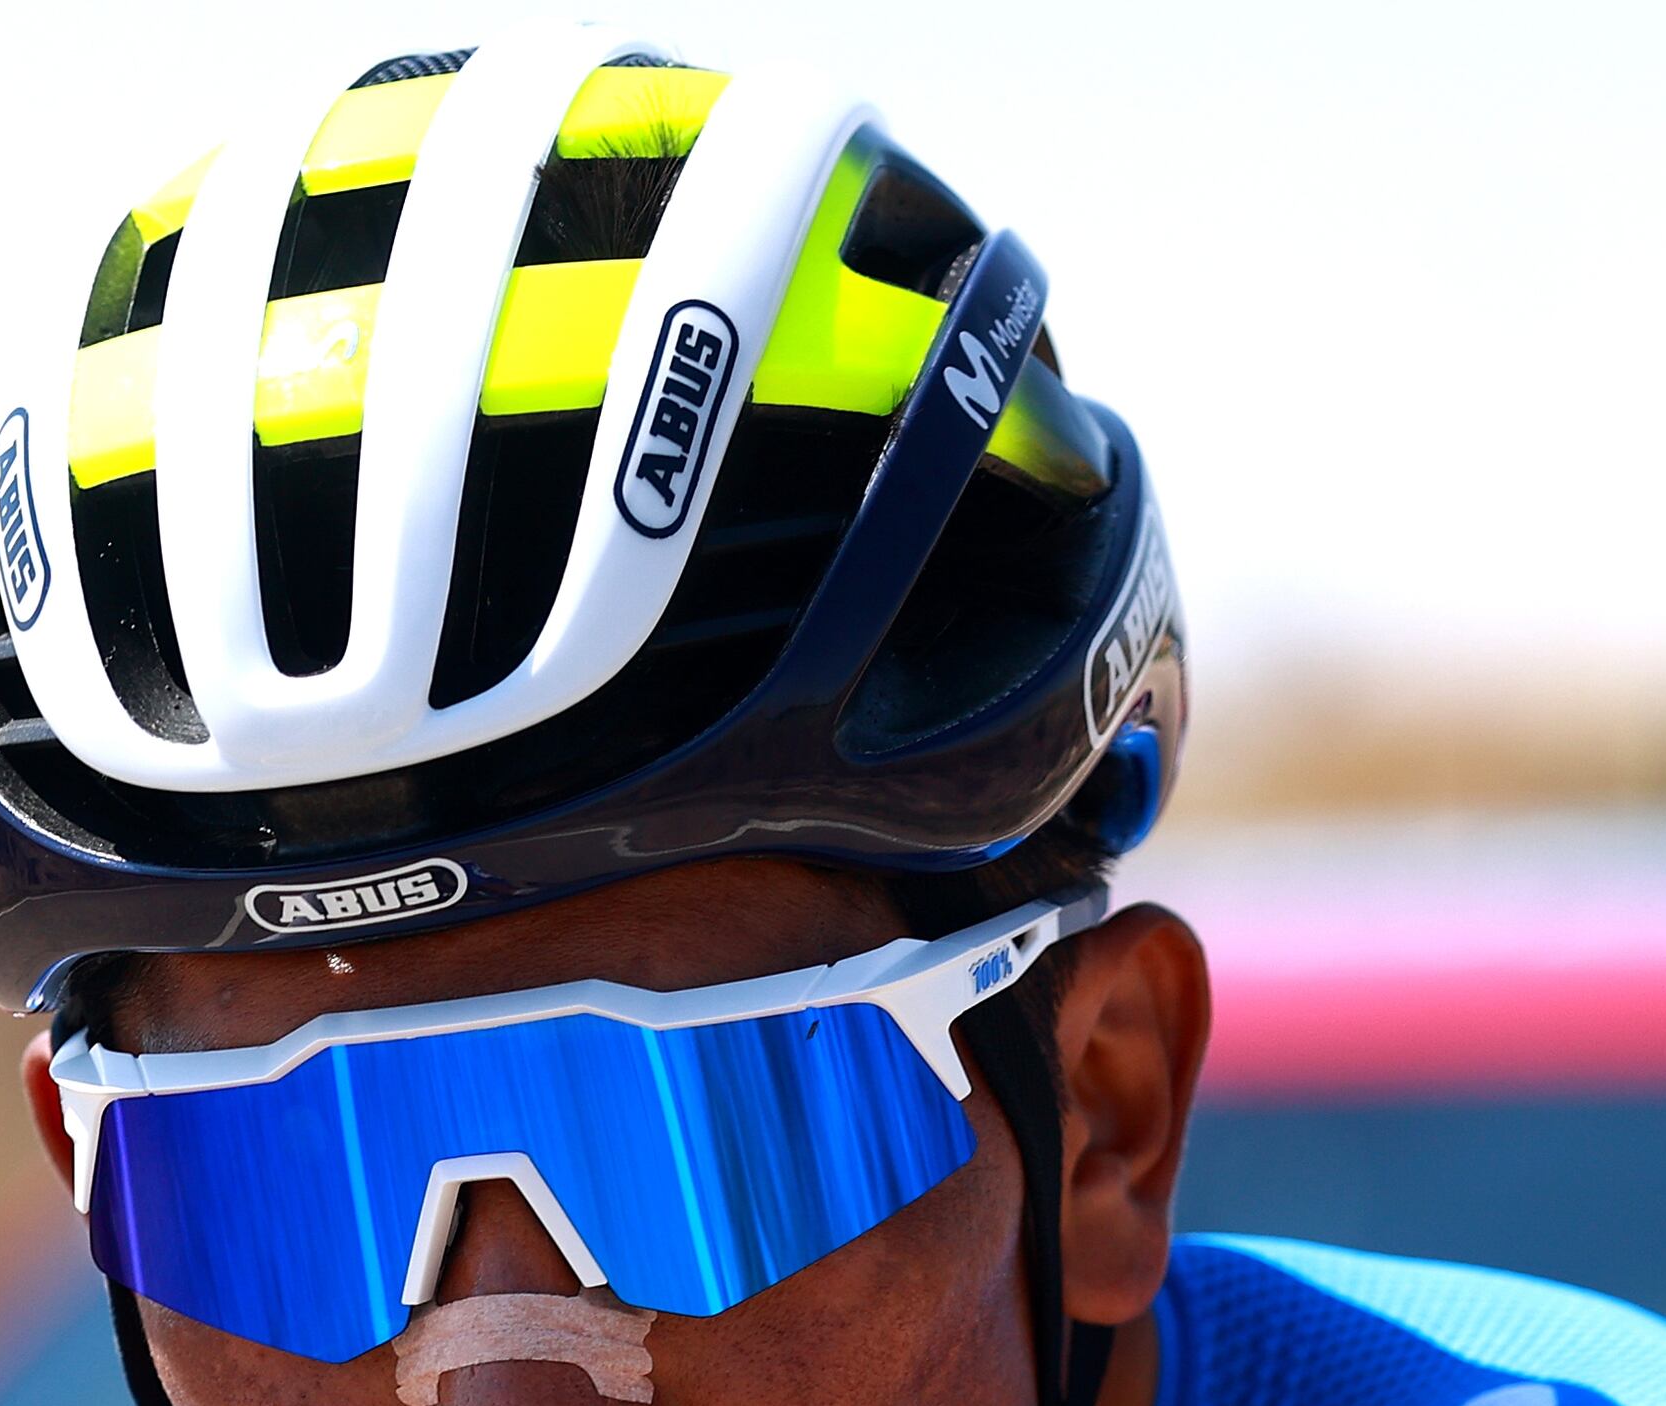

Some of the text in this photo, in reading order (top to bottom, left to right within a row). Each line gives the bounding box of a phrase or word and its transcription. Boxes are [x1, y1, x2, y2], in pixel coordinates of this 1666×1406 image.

[634, 323, 724, 508] ABUS
[1104, 532, 1169, 719] ABUS
[279, 870, 440, 925] ABUS
[971, 946, 1013, 995] 100%
